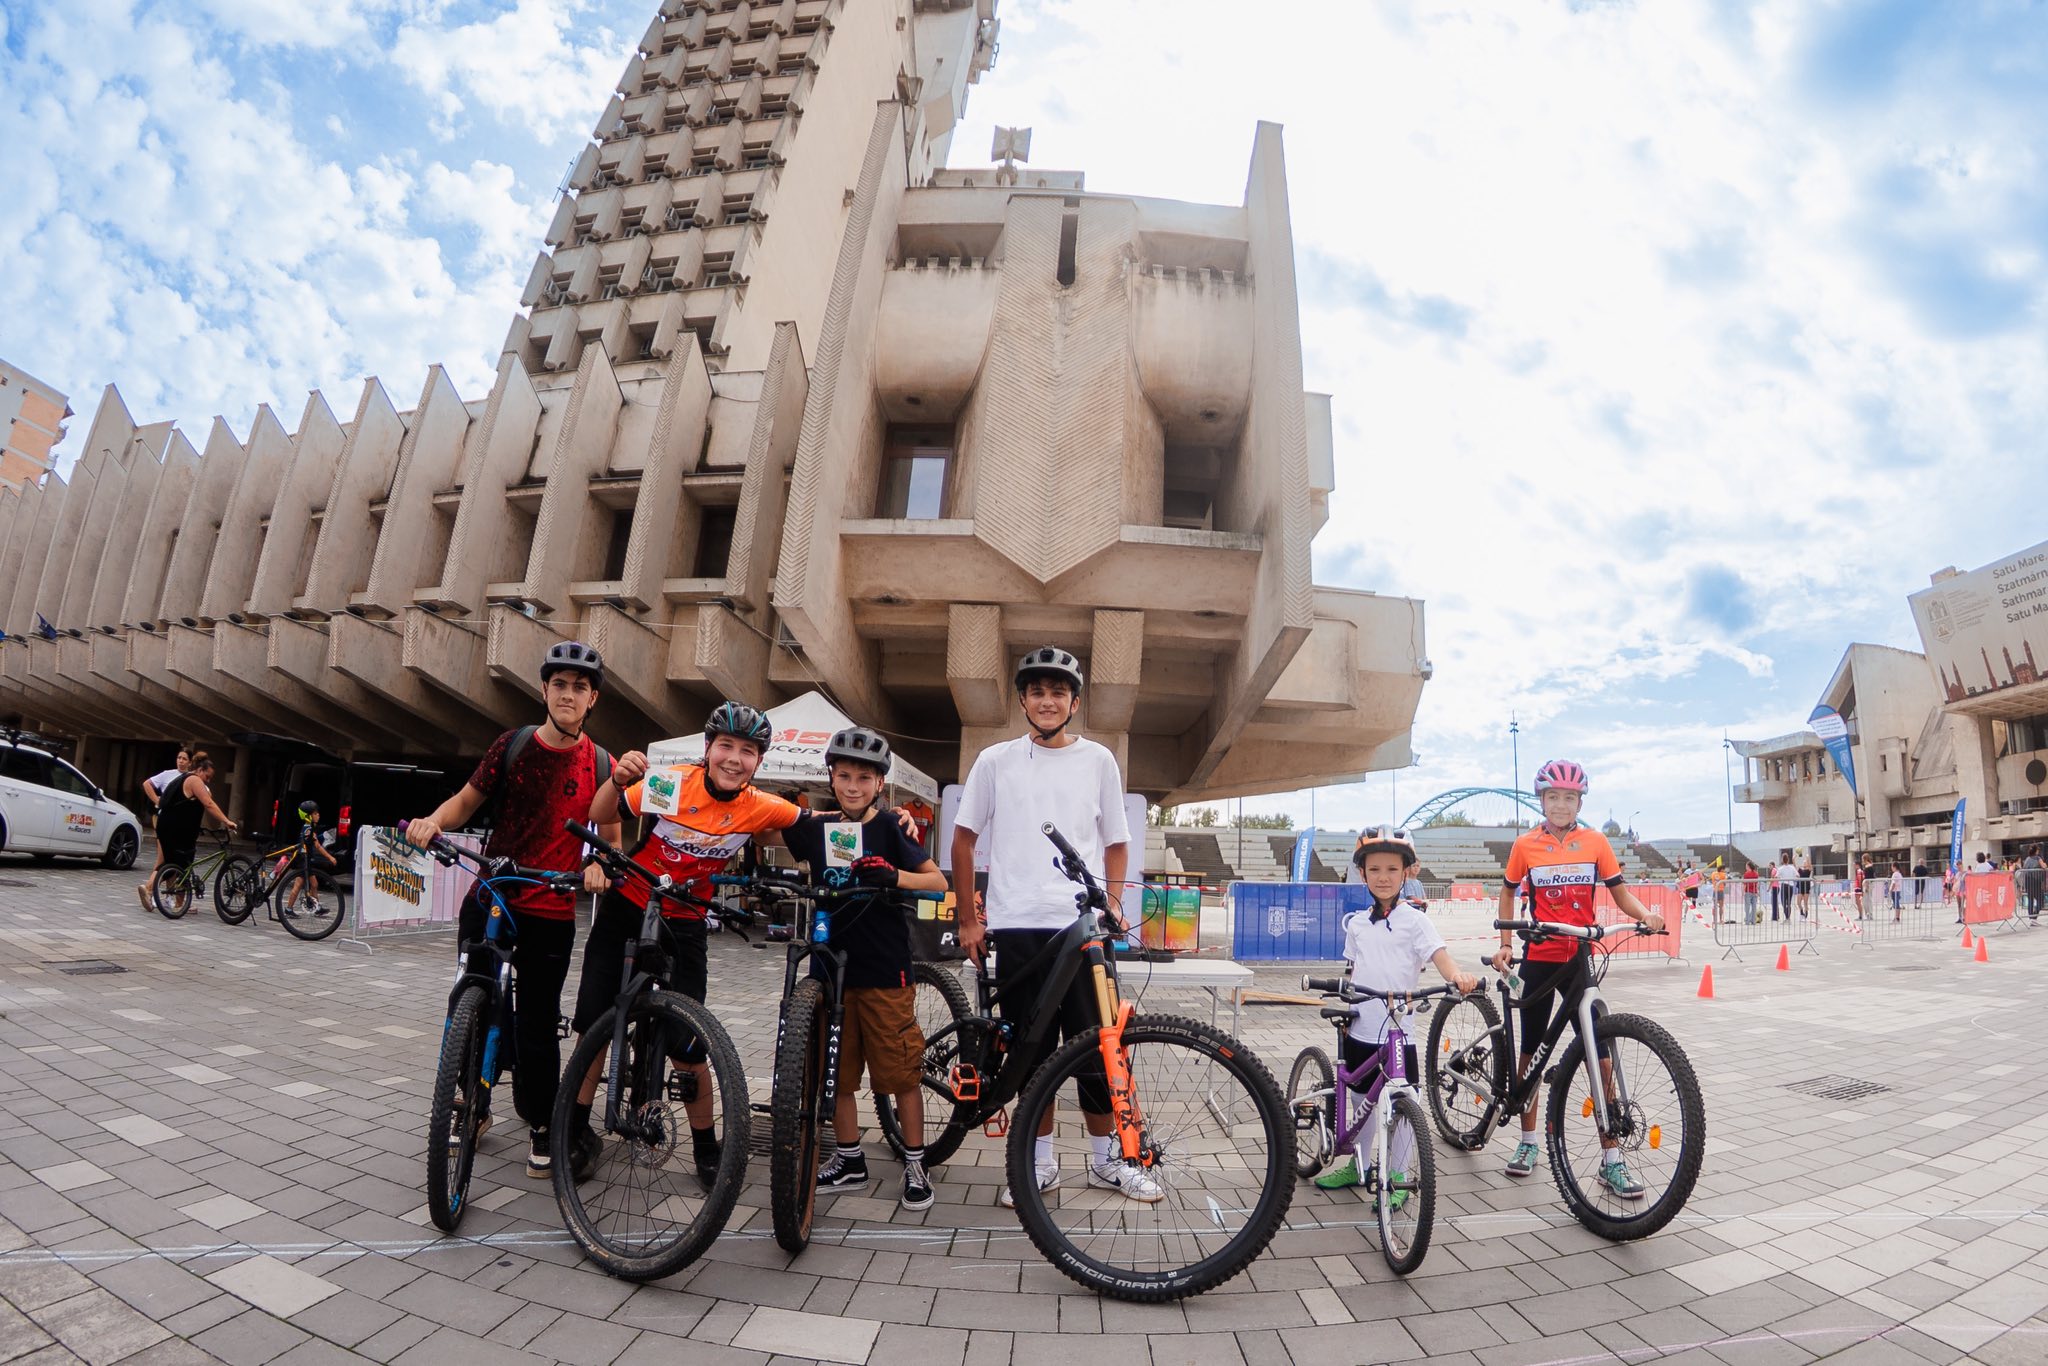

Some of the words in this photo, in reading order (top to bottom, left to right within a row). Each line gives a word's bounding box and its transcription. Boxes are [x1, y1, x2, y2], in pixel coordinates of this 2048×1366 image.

[1992, 564, 2017, 579] Satu
[2006, 609, 2031, 623] Satu
[680, 842, 732, 857] Racers
[369, 851, 426, 893] MARATONUL
[1552, 874, 1592, 884] Racers
[374, 873, 421, 907] CODRULUI
[1124, 1025, 1221, 1050] SCHWALBE
[1394, 1038, 1404, 1070] woom
[825, 1024, 841, 1098] MANITOU
[1522, 1042, 1550, 1081] woom
[1345, 1098, 1377, 1132] woom
[1061, 1251, 1115, 1285] MAGIC
[1115, 1278, 1171, 1290] MARY
